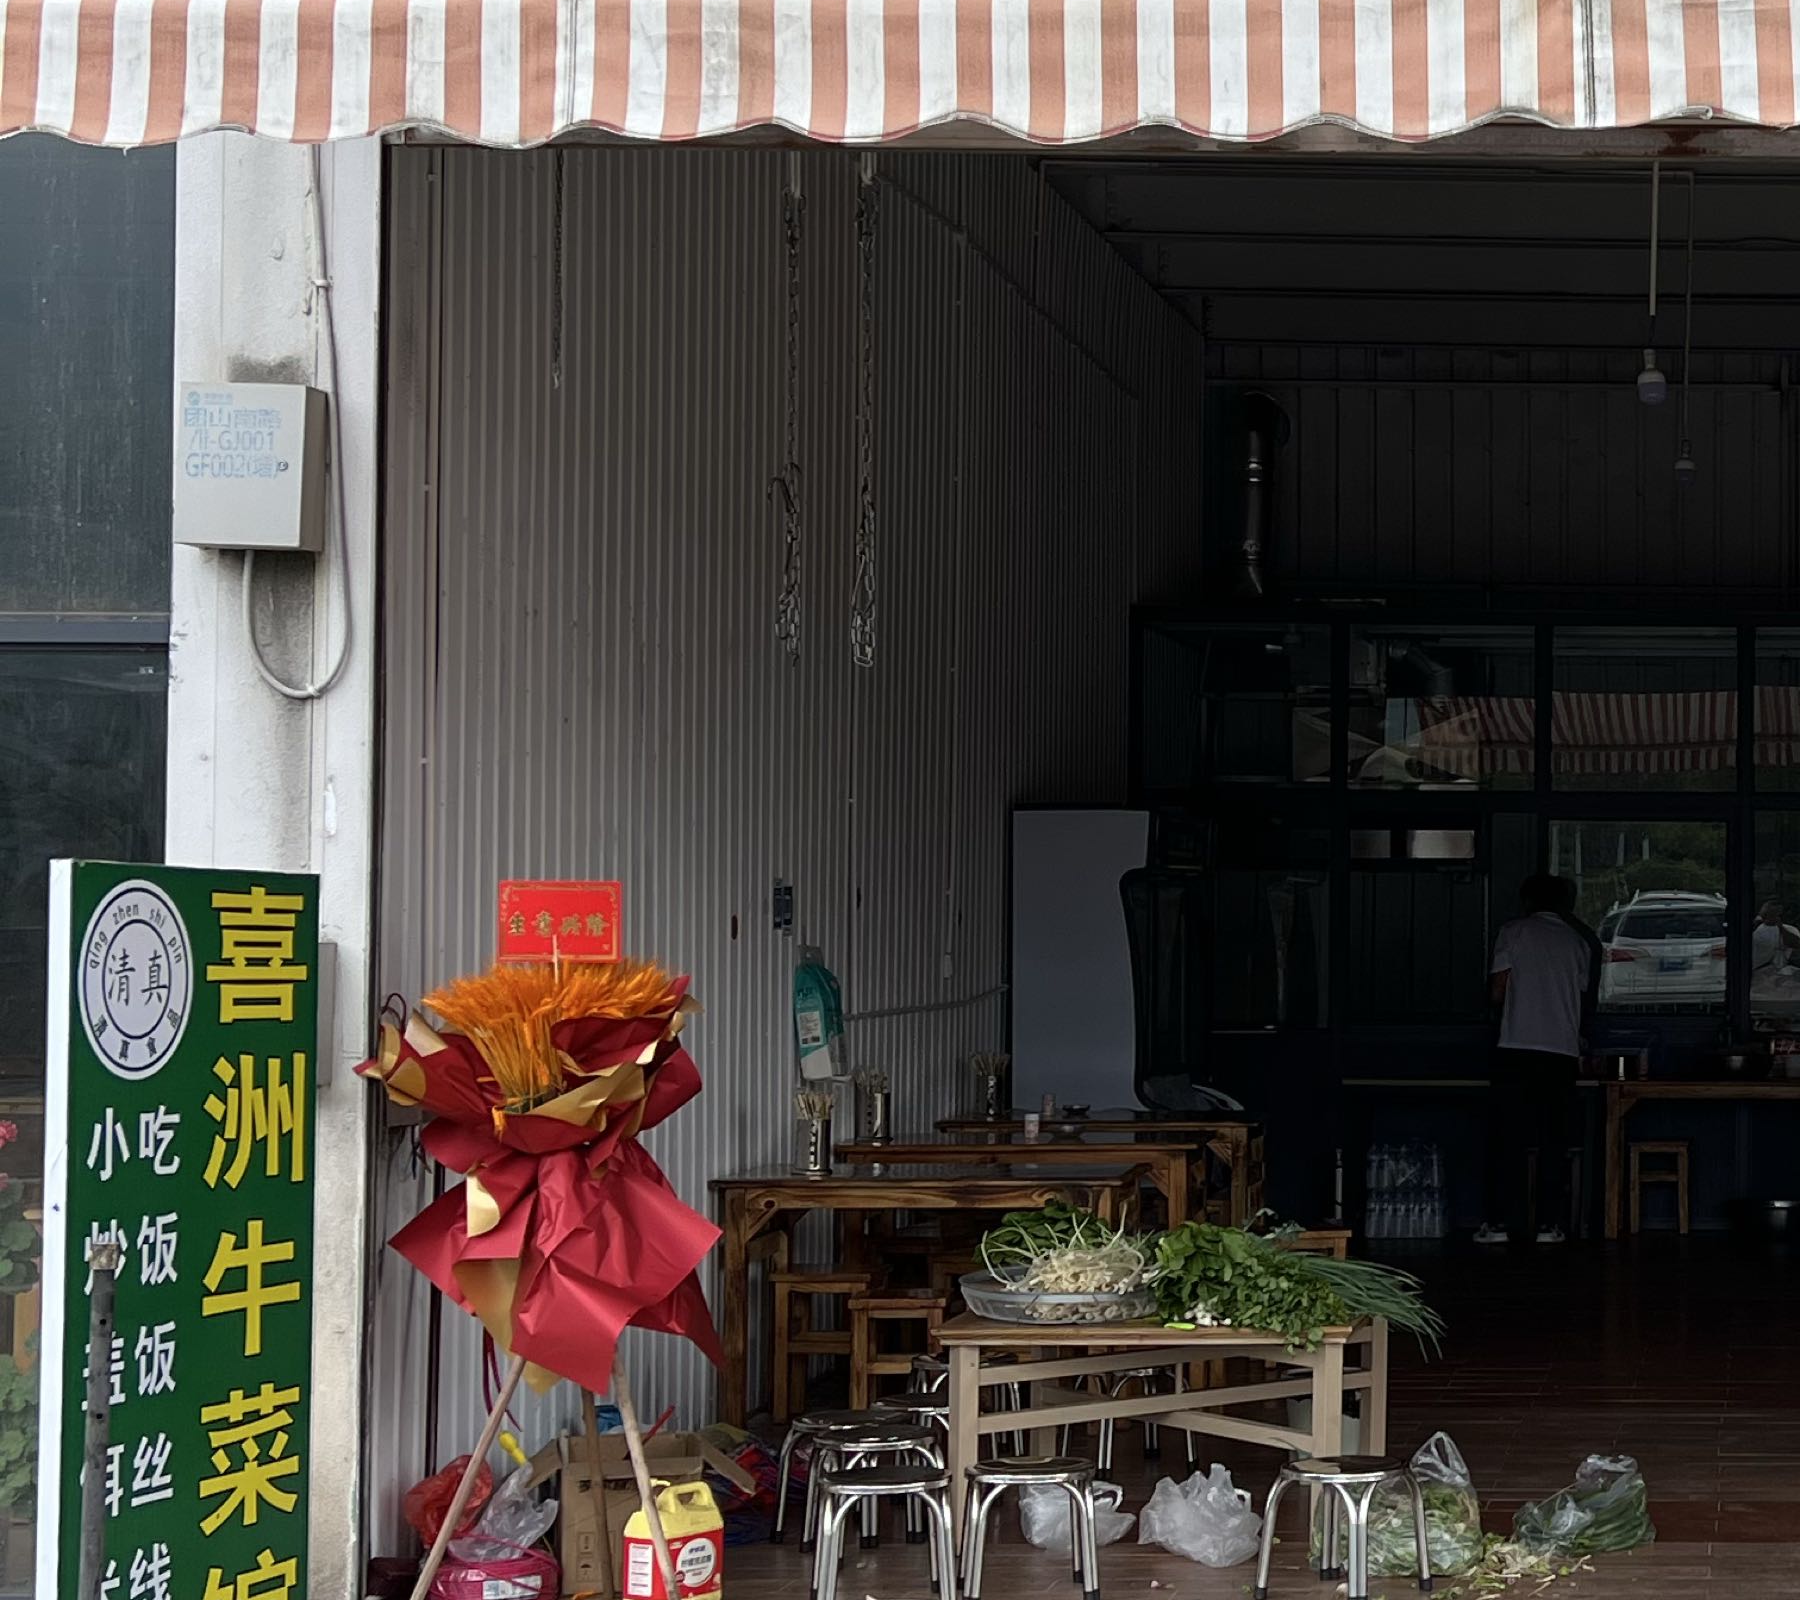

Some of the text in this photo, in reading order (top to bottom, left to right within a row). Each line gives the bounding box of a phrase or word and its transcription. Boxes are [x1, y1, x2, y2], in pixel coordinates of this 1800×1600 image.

[89, 931, 108, 969] qing
[112, 903, 139, 926] zhen
[108, 948, 169, 1006] 清真
[87, 1105, 181, 1181] 小吃
